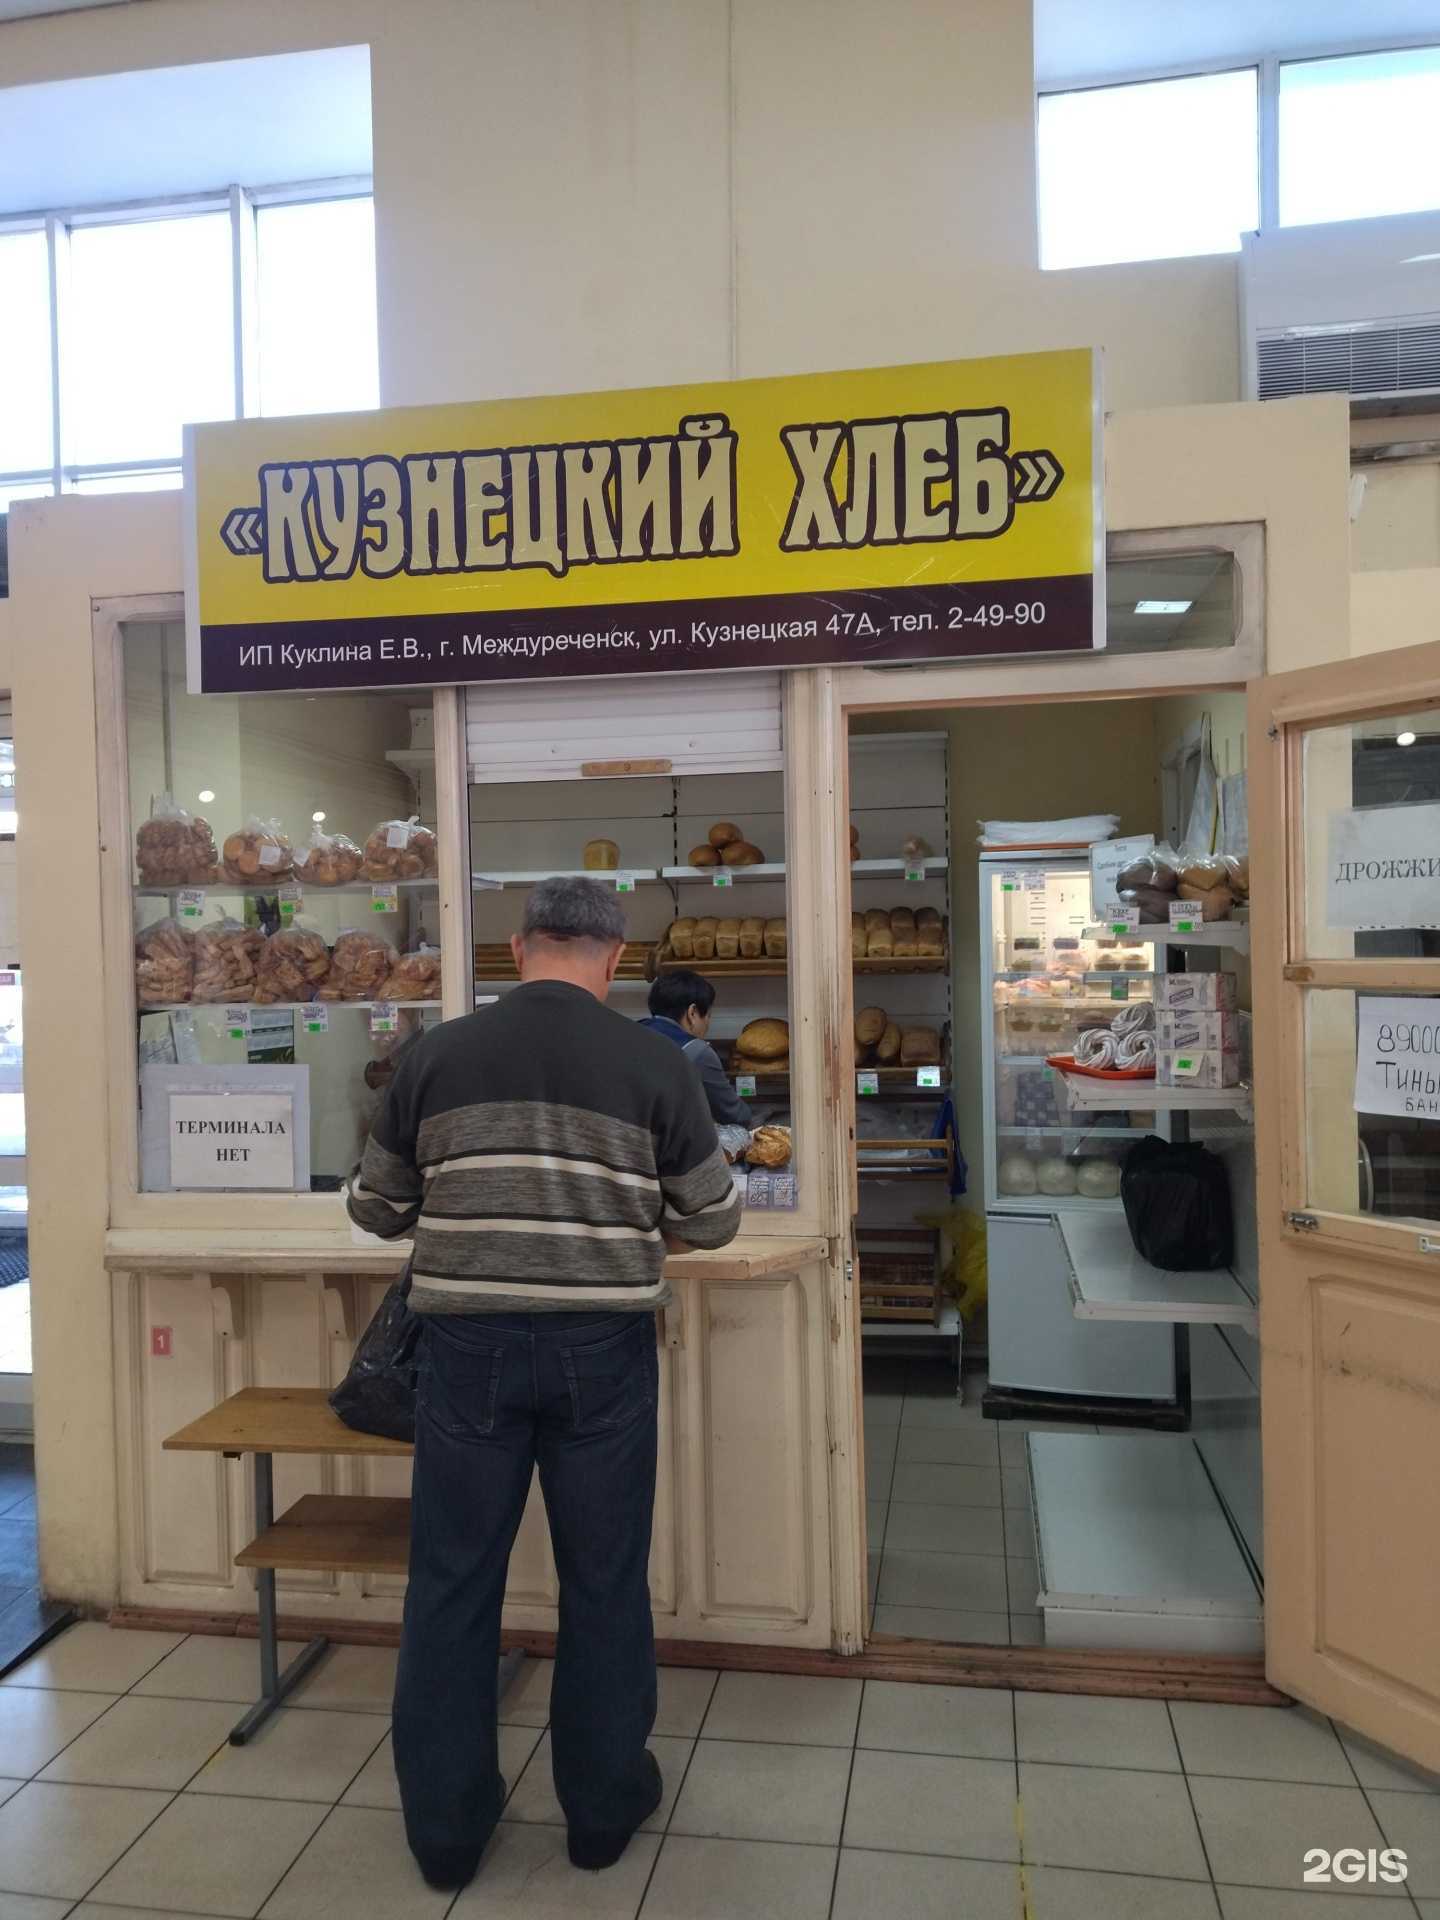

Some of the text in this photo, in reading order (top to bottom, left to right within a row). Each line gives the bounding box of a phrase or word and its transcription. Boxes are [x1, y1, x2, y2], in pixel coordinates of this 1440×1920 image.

[239, 601, 1046, 669] ИП Куклина Е.В., г. Междуреченск, ул. Кузнецкая 47А, тел. 2-49-90
[175, 1119, 287, 1136] ТЕРМИНАЛА
[216, 1147, 251, 1163] НЕТ
[156, 1335, 165, 1349] 1
